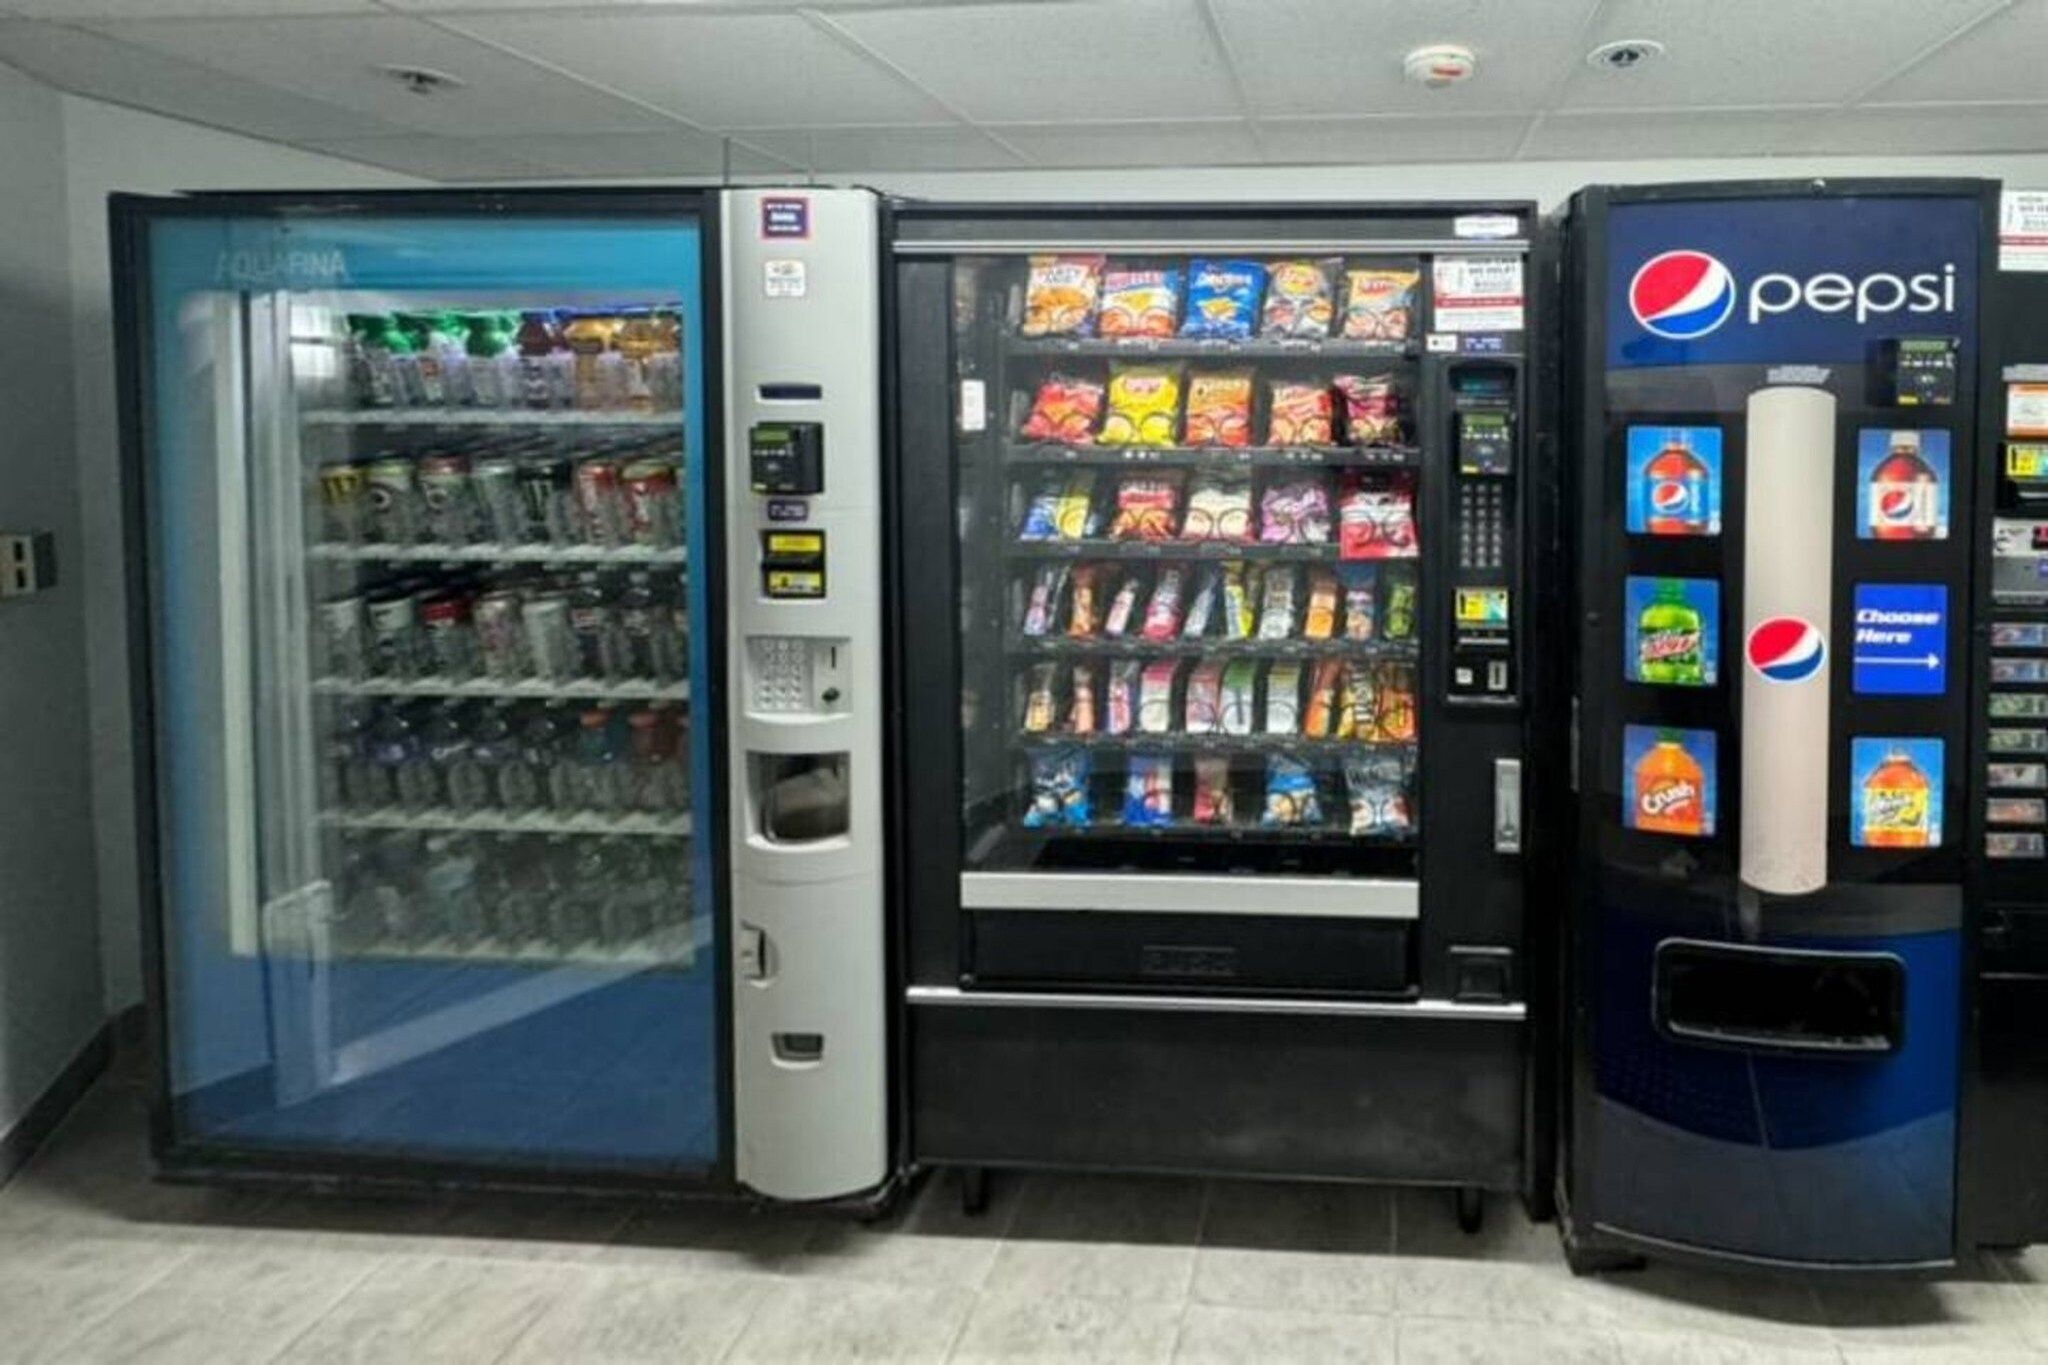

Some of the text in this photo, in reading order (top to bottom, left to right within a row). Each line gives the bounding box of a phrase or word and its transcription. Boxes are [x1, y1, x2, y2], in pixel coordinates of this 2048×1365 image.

[1749, 263, 1956, 324] pepsi
[1857, 608, 1940, 625] Choose
[1856, 629, 1911, 643] Here
